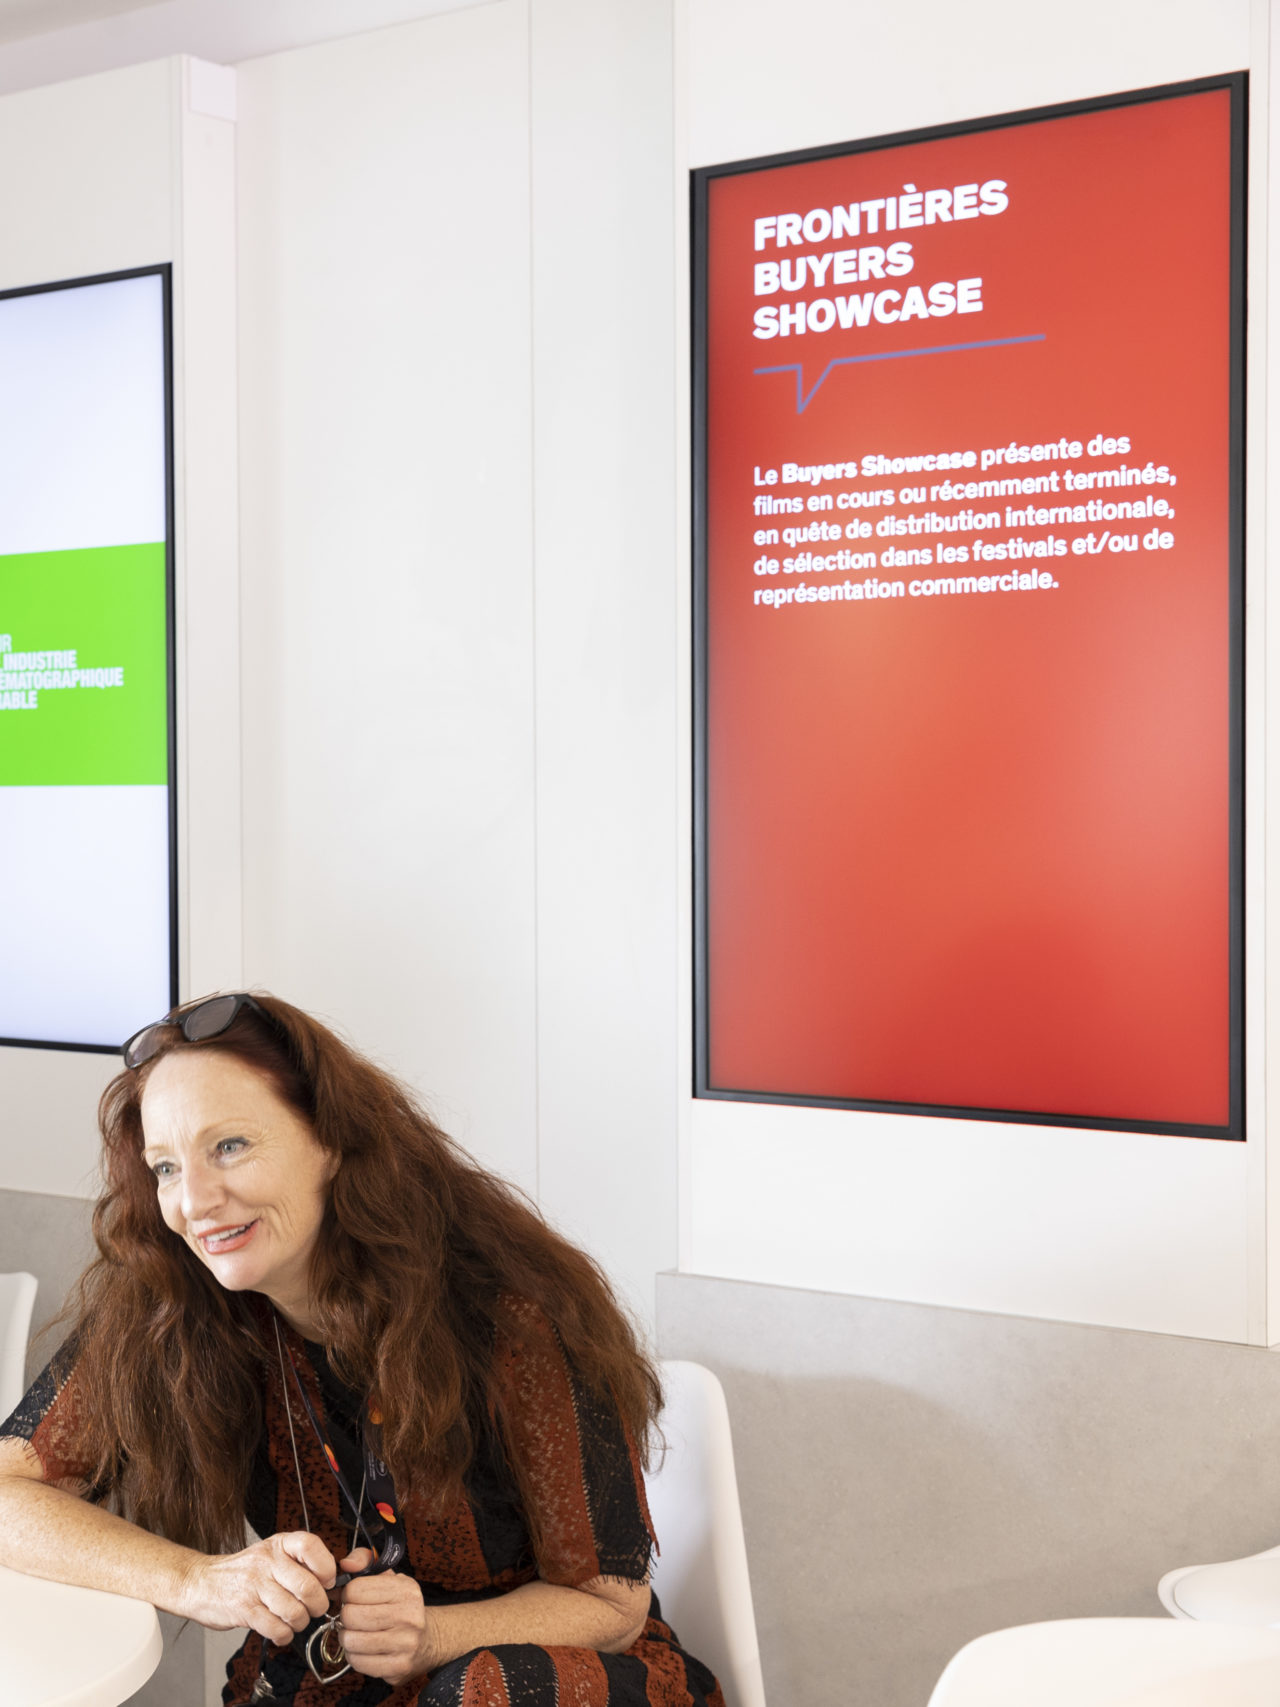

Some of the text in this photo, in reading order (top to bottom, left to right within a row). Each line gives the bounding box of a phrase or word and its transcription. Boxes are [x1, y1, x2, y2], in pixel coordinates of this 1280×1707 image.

[754, 180, 1009, 251] FRONTIÈRES
[754, 242, 915, 296] BUYERS
[753, 278, 984, 340] SHOWCASE
[754, 433, 1132, 487] Le Buyers Showcase présente des
[753, 462, 1177, 516] films en cours ou récemment terminés,
[753, 495, 1176, 548] en quête de distribution internationale,
[753, 527, 1175, 576] de sélection dans les festivals et/ou de
[753, 567, 1060, 609] représentation commerciale.
[3, 650, 77, 671] INDUSTRIE
